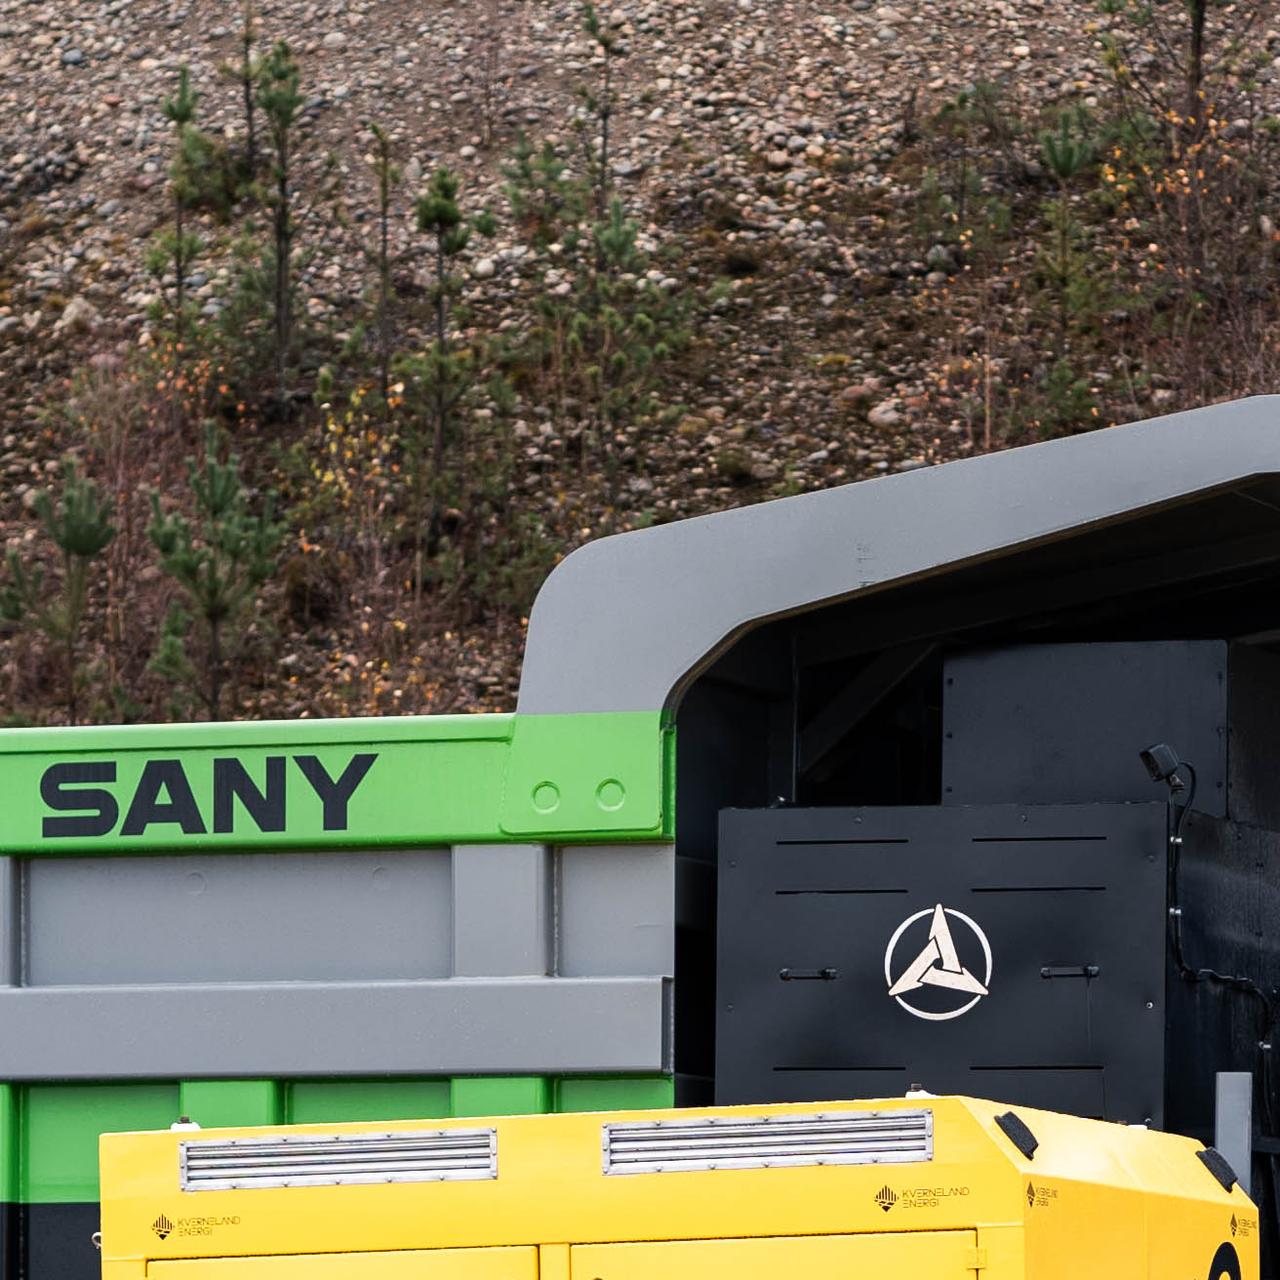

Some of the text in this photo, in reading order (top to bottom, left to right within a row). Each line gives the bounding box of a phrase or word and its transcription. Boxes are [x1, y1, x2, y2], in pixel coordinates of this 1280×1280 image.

[40, 754, 379, 839] SANY
[902, 1186, 970, 1199] KVERNELAND
[902, 1198, 940, 1209] ENERGI
[177, 1215, 241, 1227] KVERNELAND
[177, 1226, 213, 1238] ENERGI
